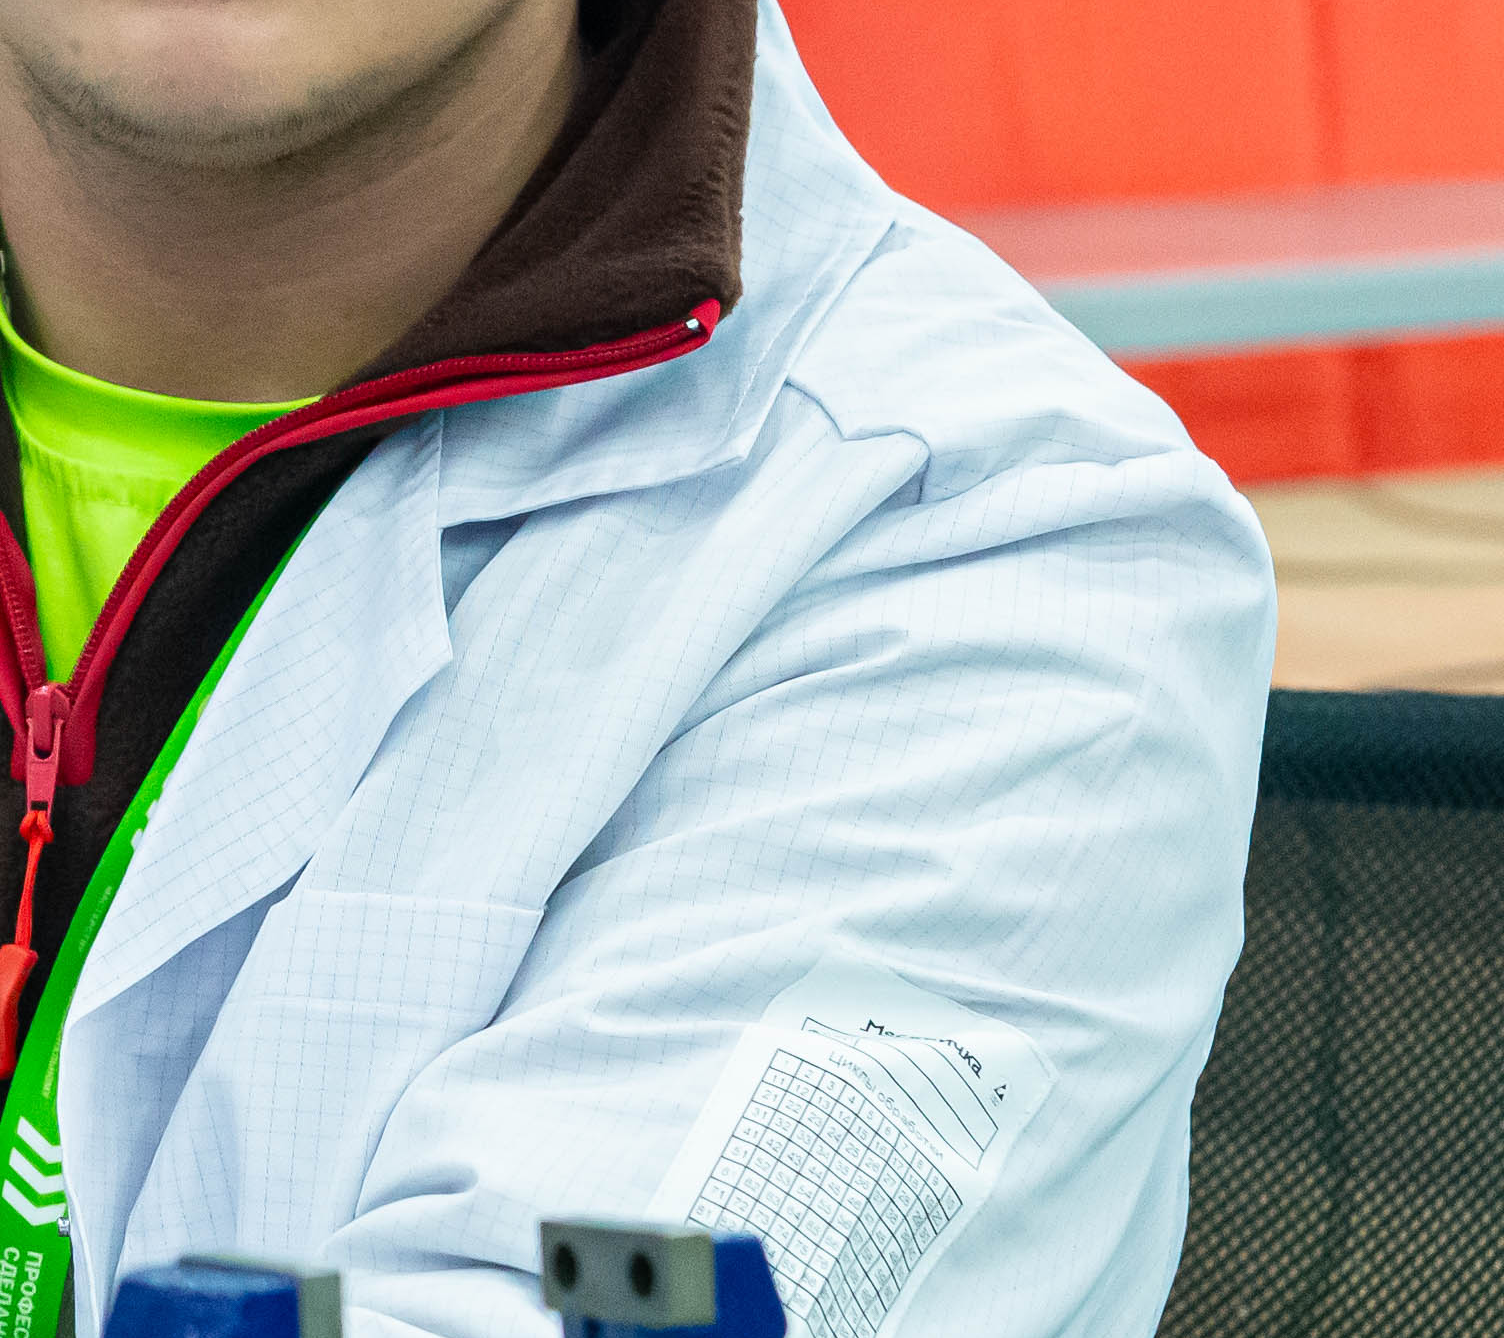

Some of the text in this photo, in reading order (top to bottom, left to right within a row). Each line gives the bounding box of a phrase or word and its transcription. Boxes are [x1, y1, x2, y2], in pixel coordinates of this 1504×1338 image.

[752, 1107, 768, 1119] 31
[775, 1117, 791, 1131] 32
[797, 1130, 811, 1145] 33
[762, 1090, 777, 1102] 21
[785, 1100, 801, 1114] 22
[808, 1111, 822, 1127] 23
[827, 1126, 842, 1143] 24
[846, 1142, 859, 1157] 25
[865, 1157, 880, 1173] 26
[773, 1075, 785, 1085] 11
[796, 1085, 809, 1096] 12
[818, 1096, 831, 1109] 13
[839, 1111, 851, 1124] 14
[856, 1126, 868, 1140] 15
[875, 1142, 887, 1155] 16
[893, 1157, 904, 1169] 17
[804, 1069, 813, 1078] 2
[827, 1081, 835, 1091] 3
[848, 1095, 856, 1104] 4
[867, 1110, 874, 1120] 5
[885, 1127, 891, 1136] 6
[902, 1142, 908, 1152] 7
[828, 1050, 944, 1161] Циклы обработки
[731, 1146, 747, 1158] 51
[744, 1128, 758, 1138] 41
[767, 1139, 782, 1152] 42
[787, 1152, 801, 1166] 43
[712, 1185, 725, 1198] 71
